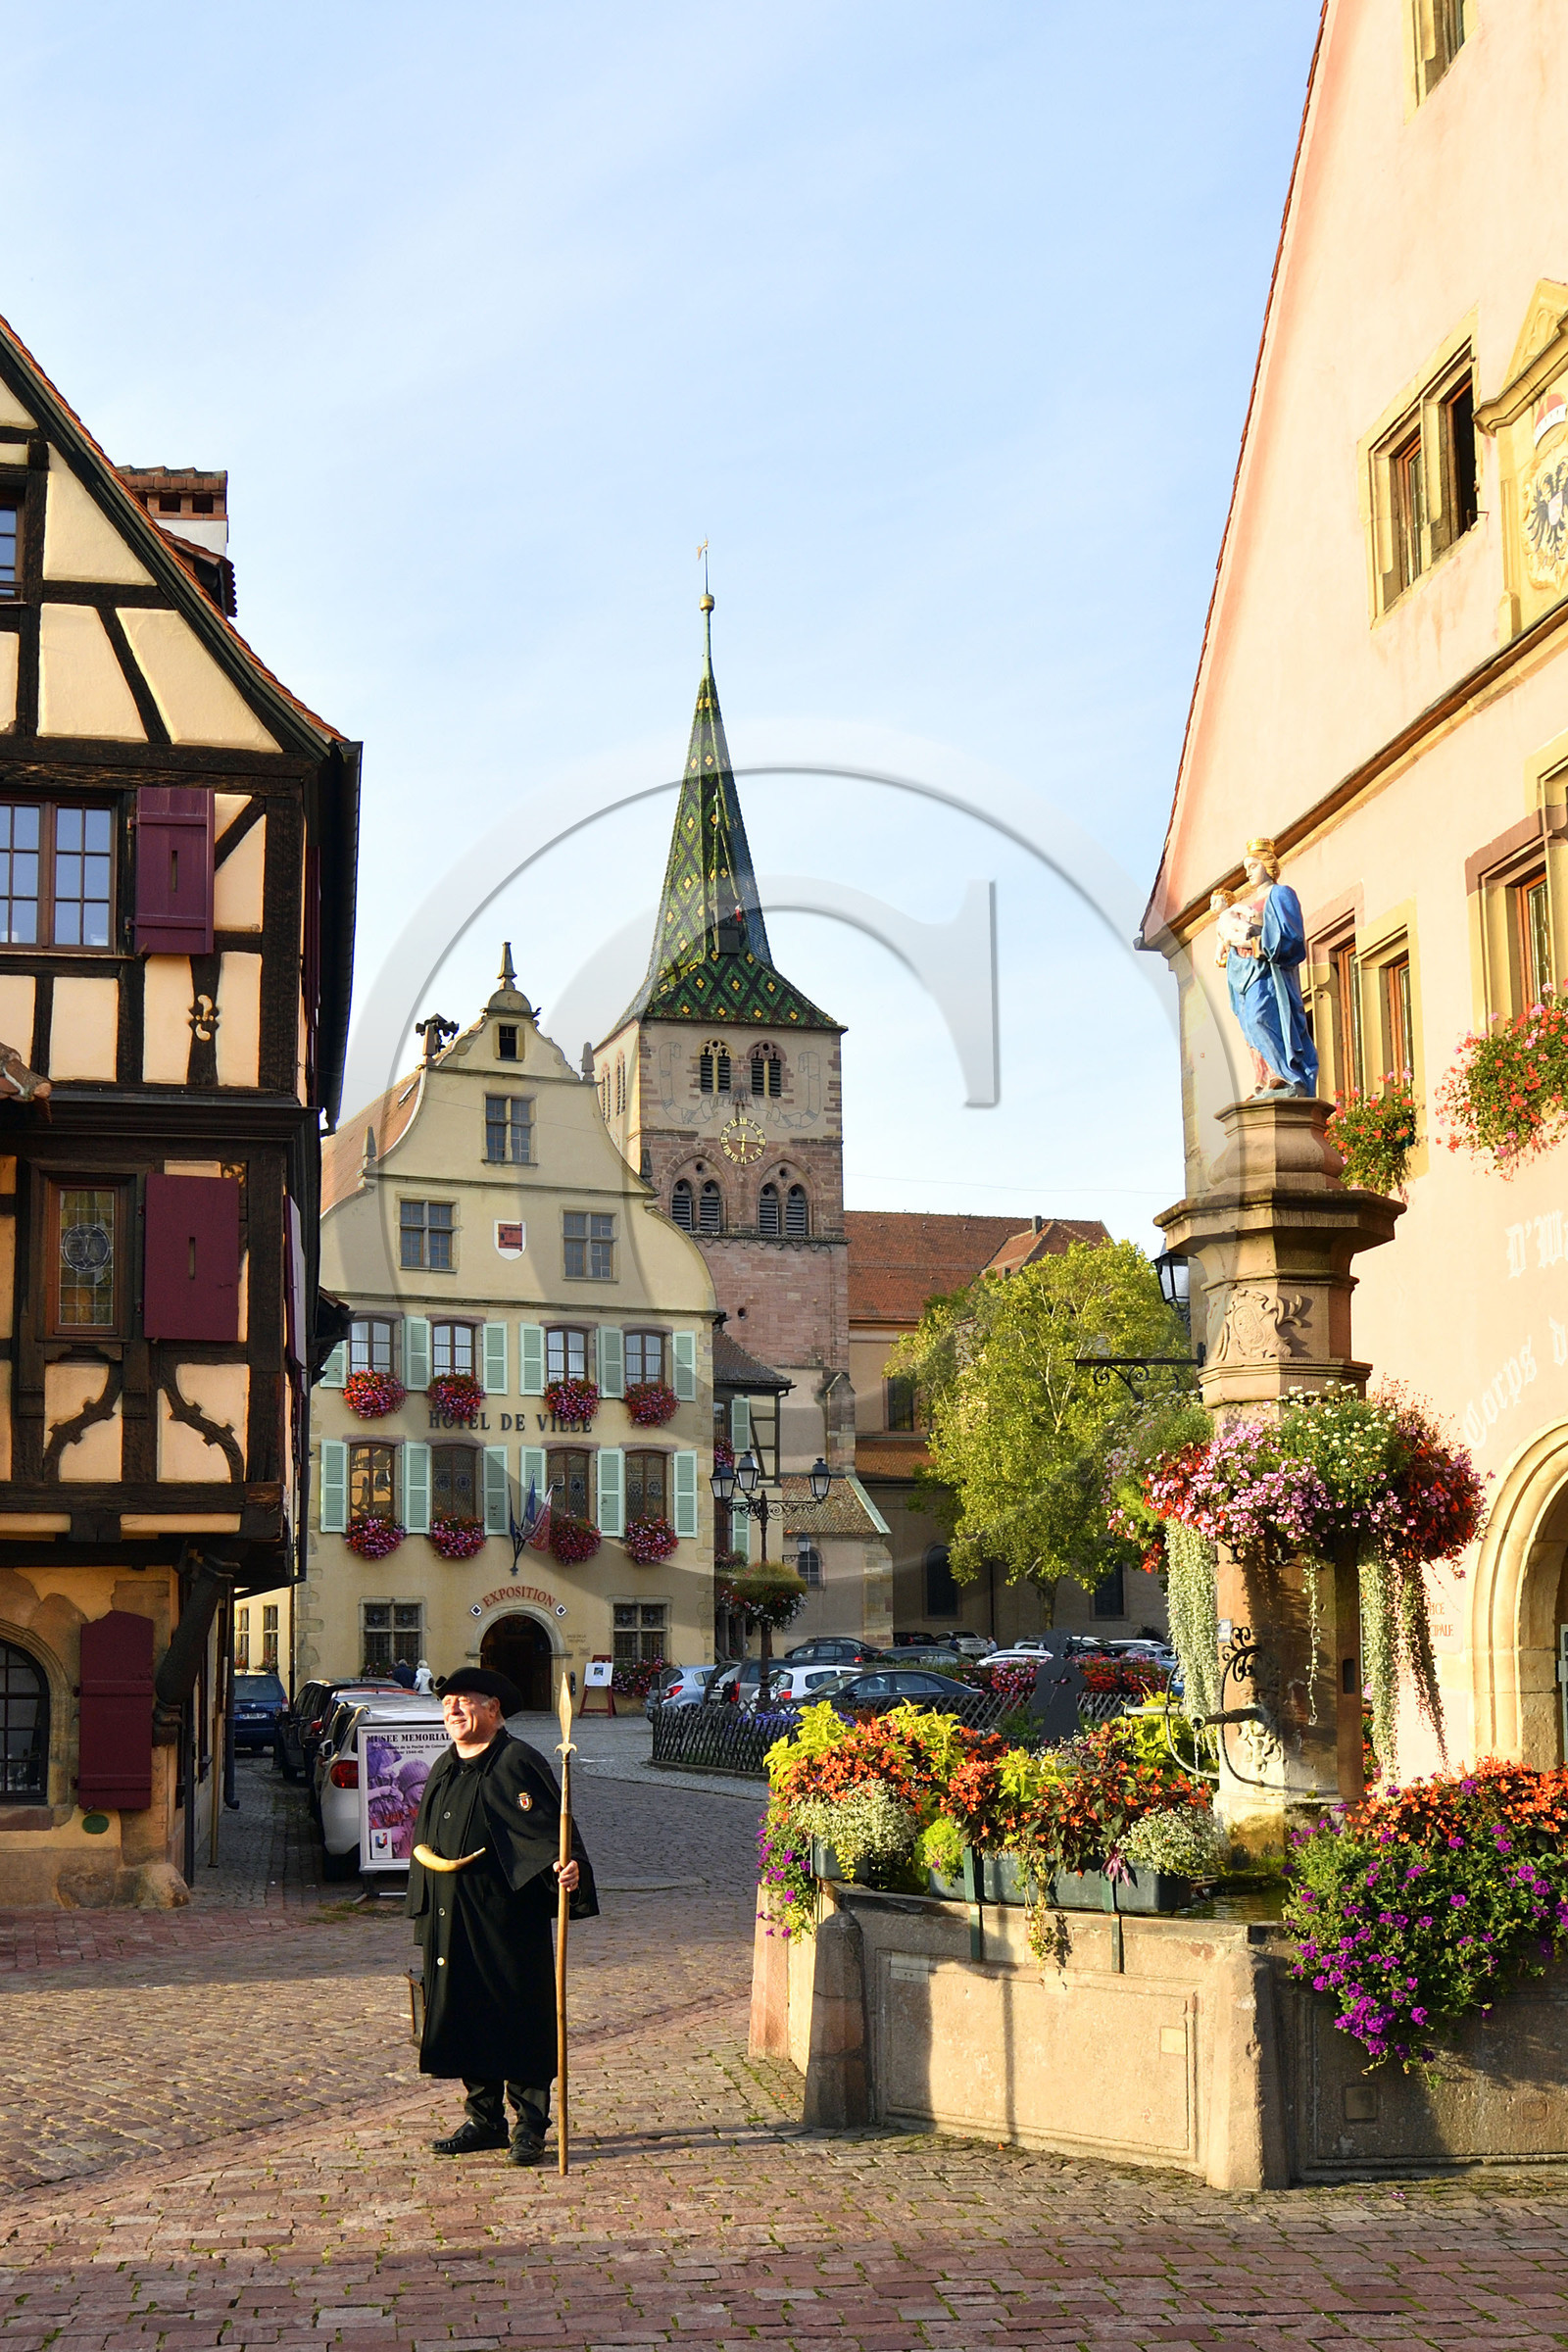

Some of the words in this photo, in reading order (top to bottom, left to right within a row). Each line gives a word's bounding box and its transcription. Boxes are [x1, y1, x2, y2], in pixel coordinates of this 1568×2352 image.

[501, 1412, 526, 1432] DE
[536, 1413, 592, 1433] VILLE
[482, 1586, 557, 1607] EXPOSITION
[367, 1735, 399, 1743] MUSEE
[401, 1733, 452, 1741] MEMORIAL
